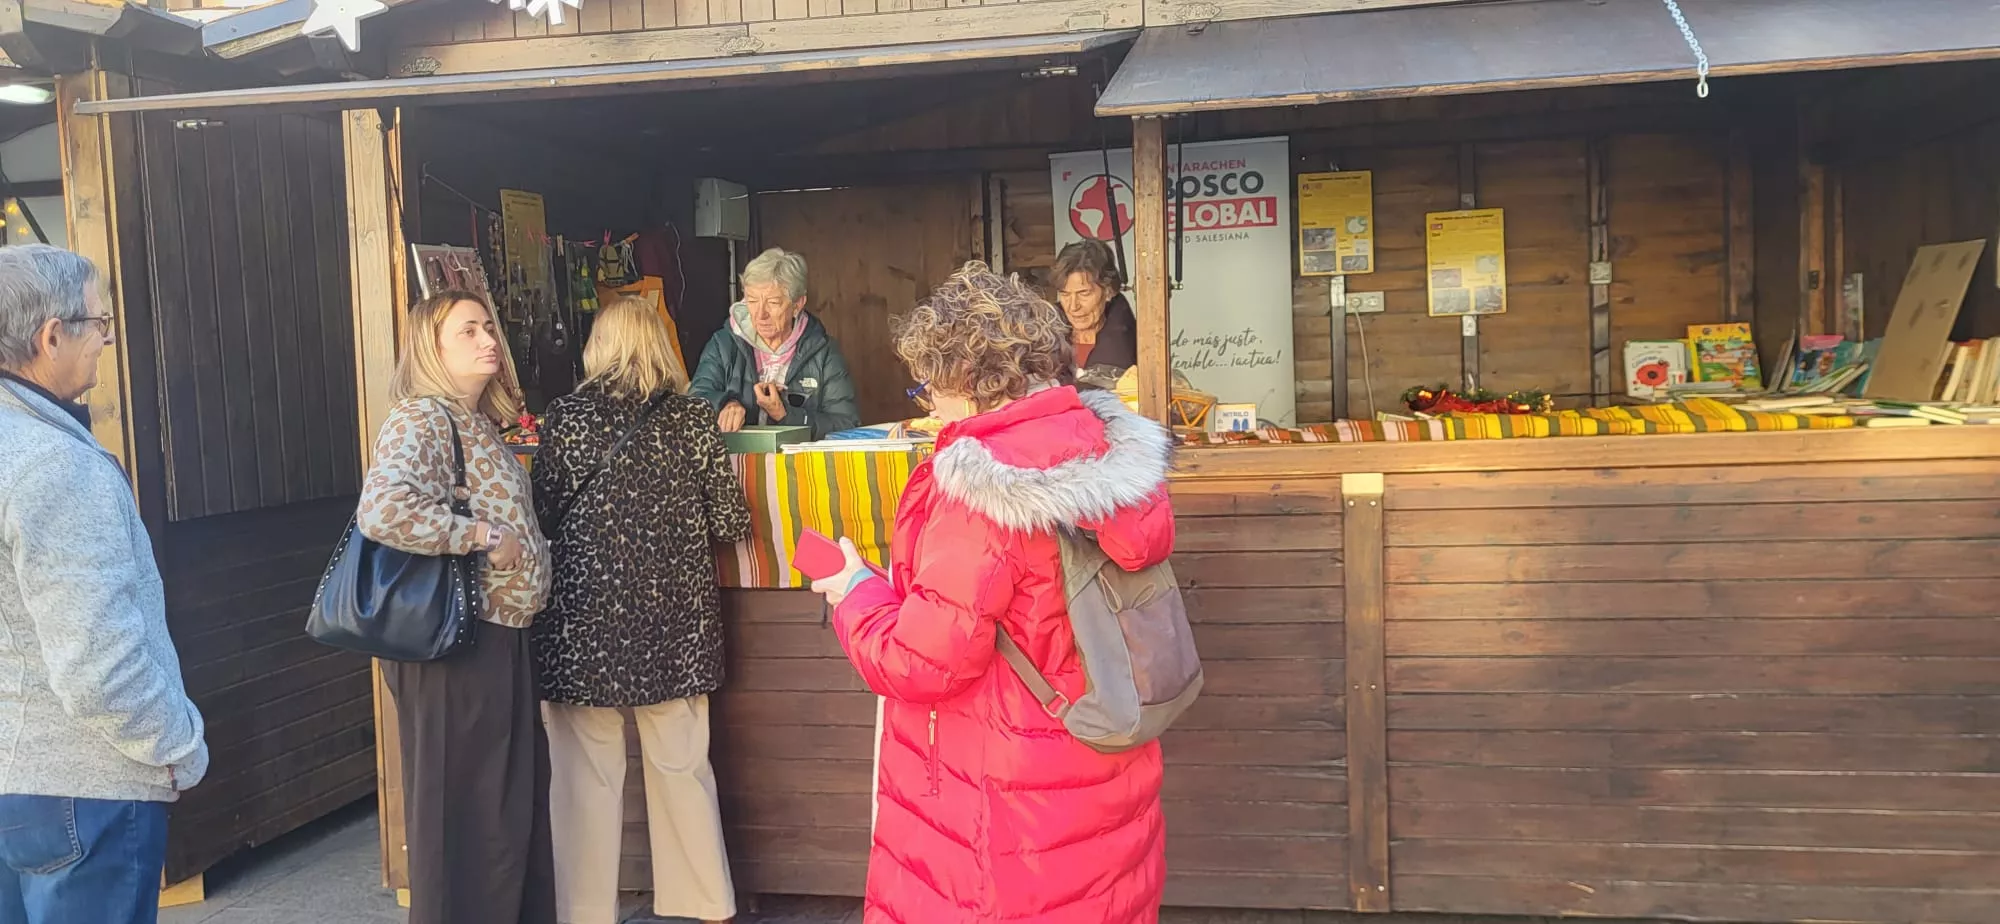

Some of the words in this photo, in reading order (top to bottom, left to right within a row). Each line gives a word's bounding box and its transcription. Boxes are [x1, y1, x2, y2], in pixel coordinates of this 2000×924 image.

[1196, 232, 1249, 243] SALESIANA
[1170, 329, 1189, 347] do
[1193, 332, 1220, 348] más
[1171, 350, 1227, 370] tenible...
